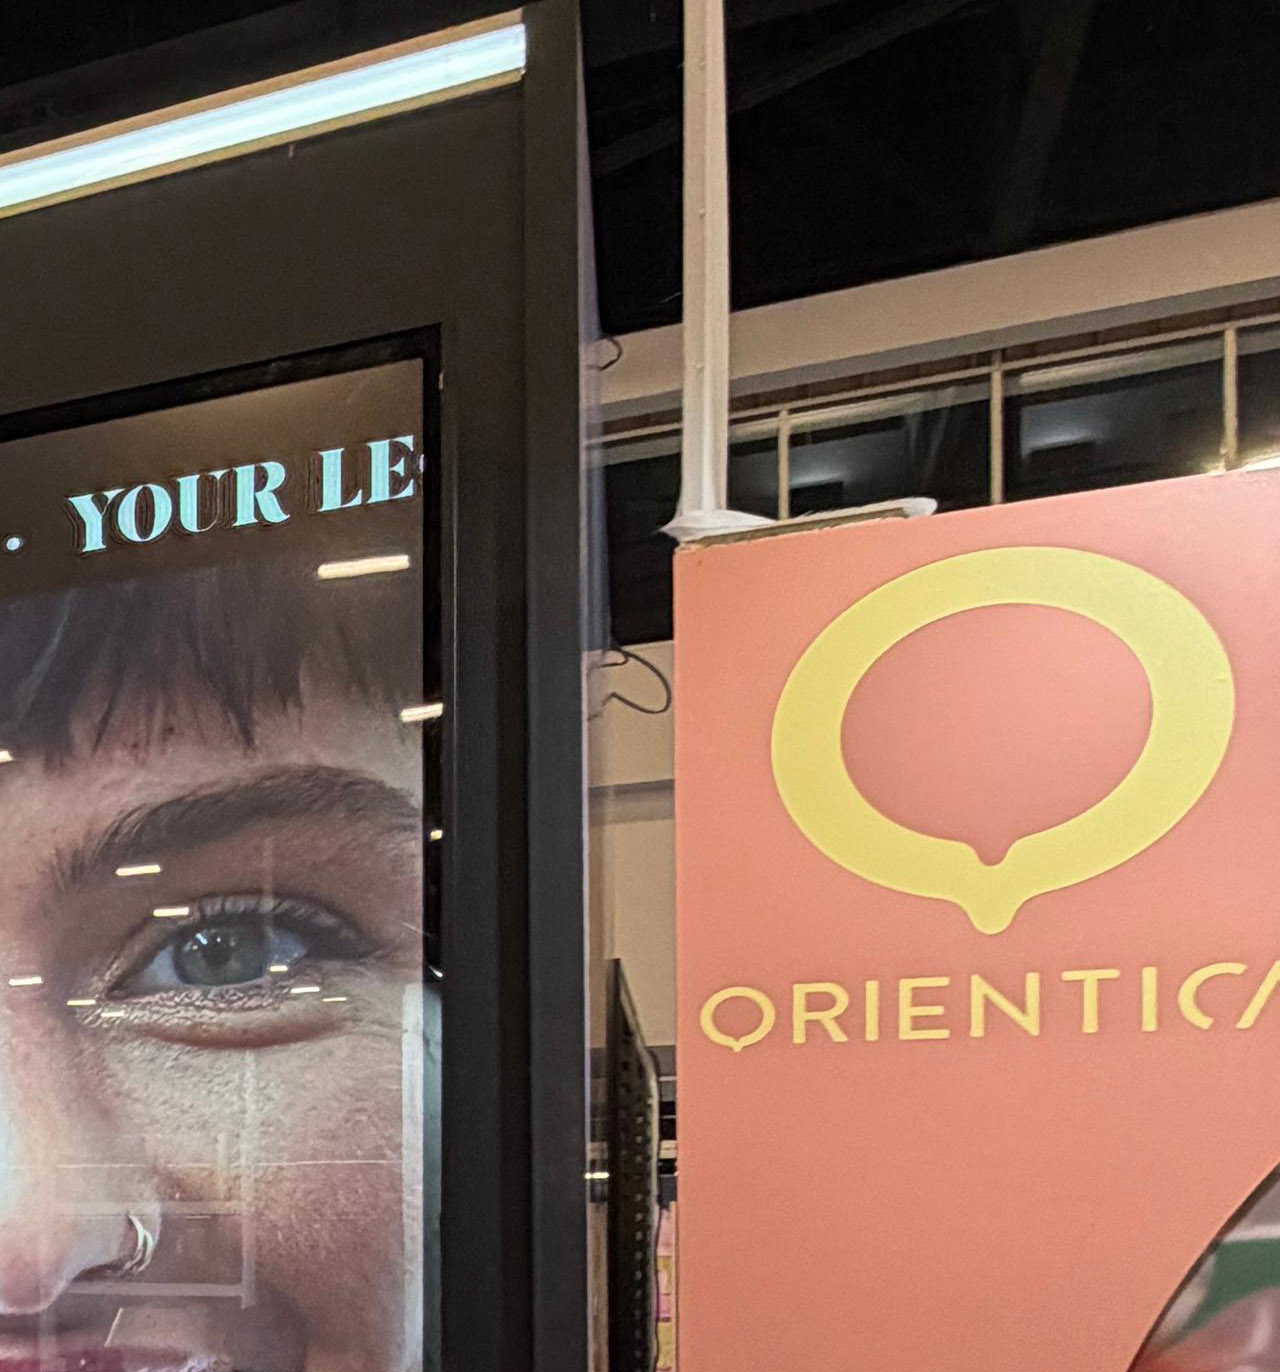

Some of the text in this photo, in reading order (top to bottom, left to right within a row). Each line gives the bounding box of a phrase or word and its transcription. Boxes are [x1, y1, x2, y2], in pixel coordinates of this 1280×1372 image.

[67, 460, 291, 553] YOUR
[317, 434, 424, 513] LE
[698, 960, 1280, 1053] ORIENTIC
